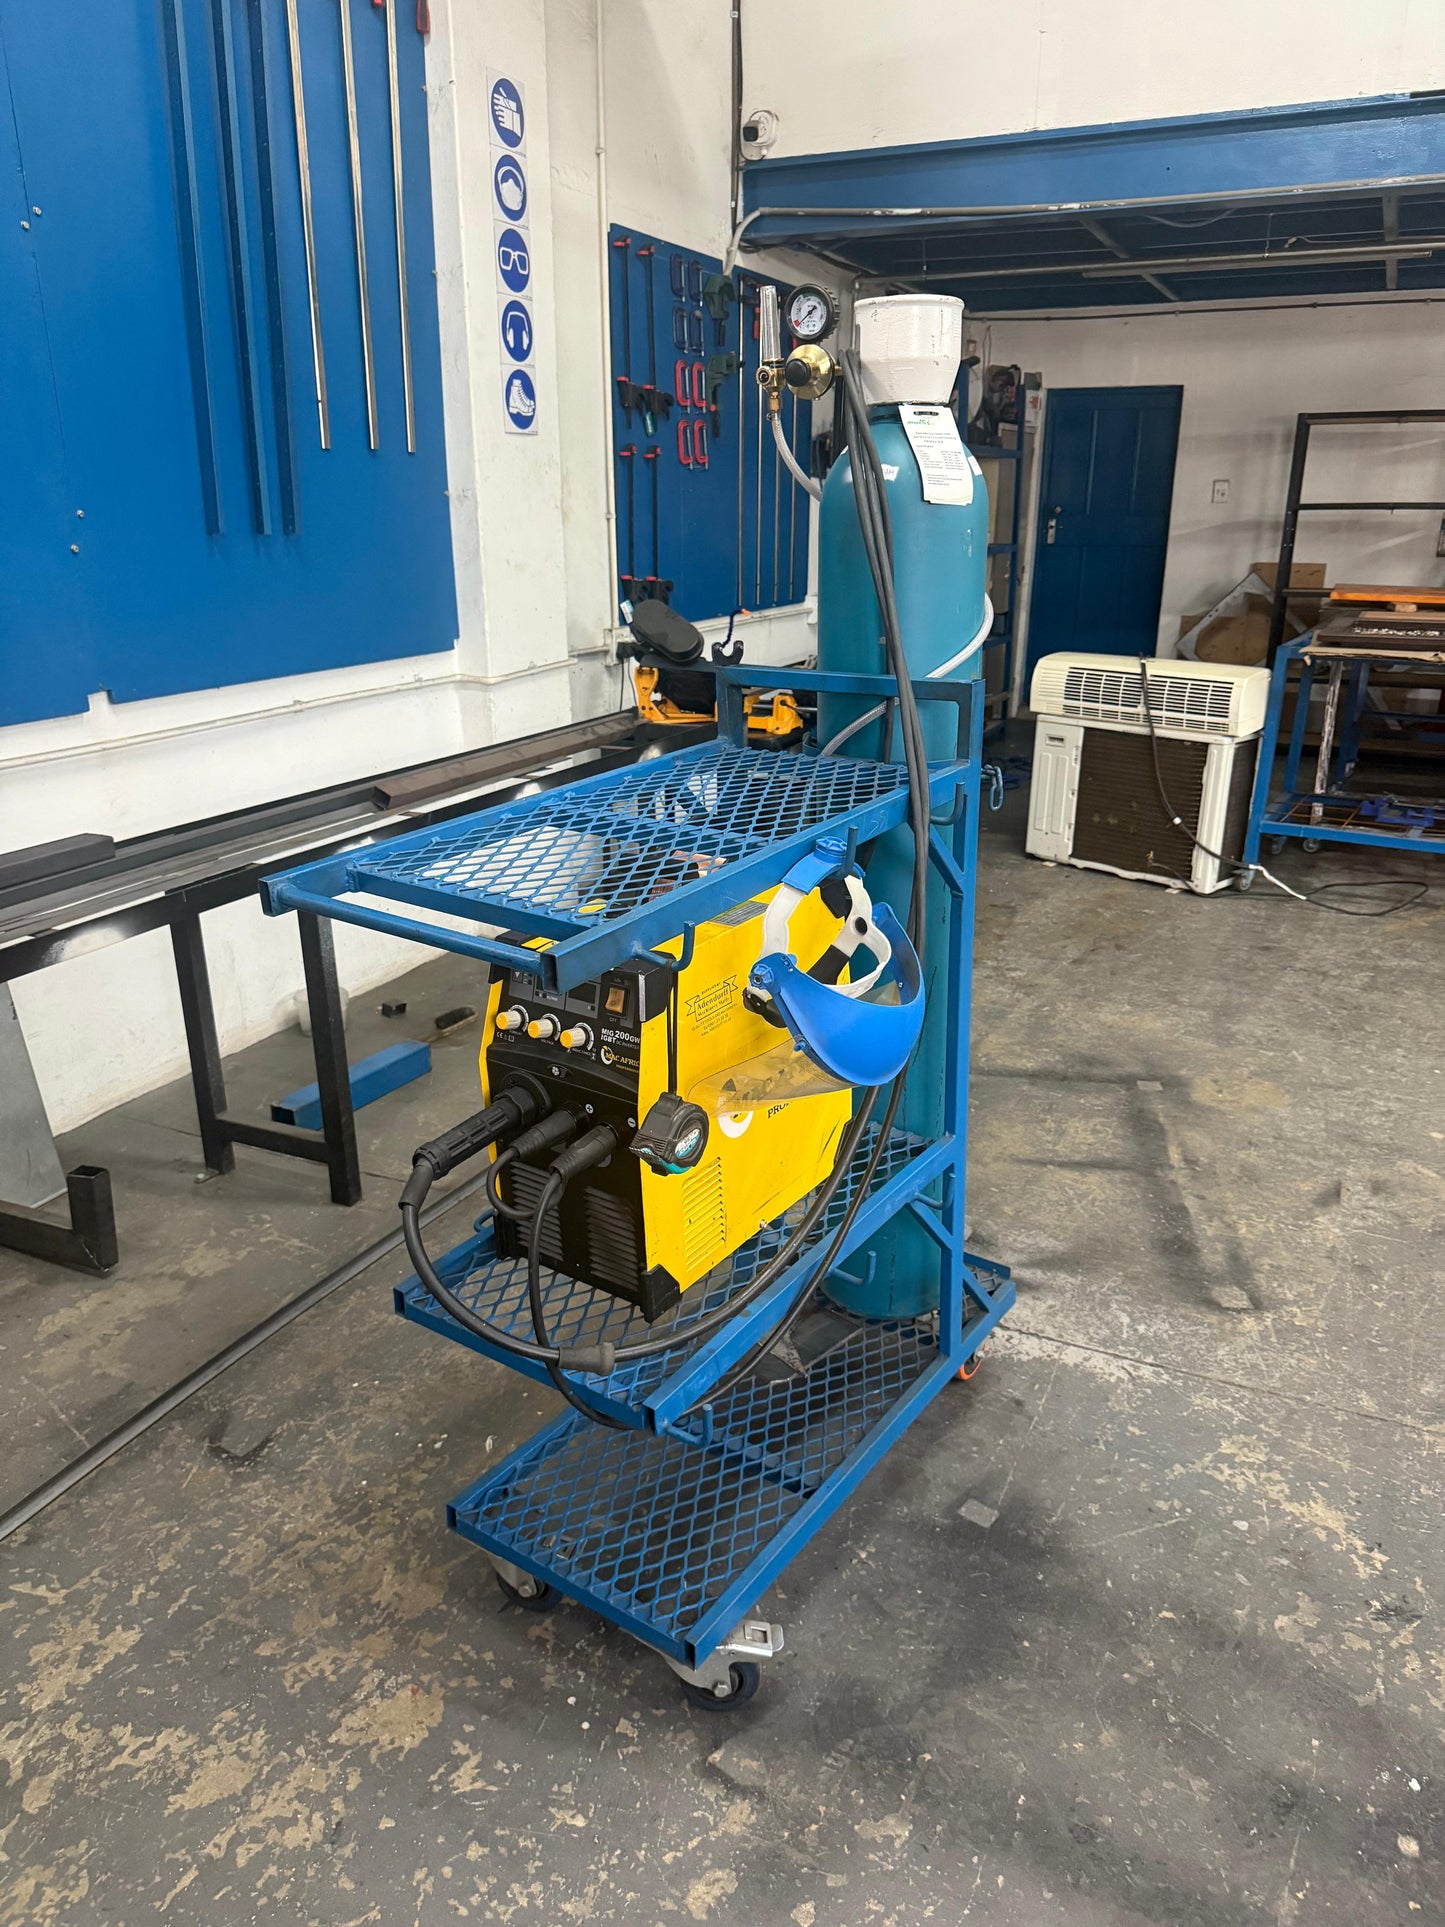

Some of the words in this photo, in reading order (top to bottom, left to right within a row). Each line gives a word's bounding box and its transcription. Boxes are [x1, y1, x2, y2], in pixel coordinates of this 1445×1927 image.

[697, 987, 729, 1010] Adendorff
[601, 1027, 614, 1037] MIG
[600, 1034, 616, 1044] IGBT
